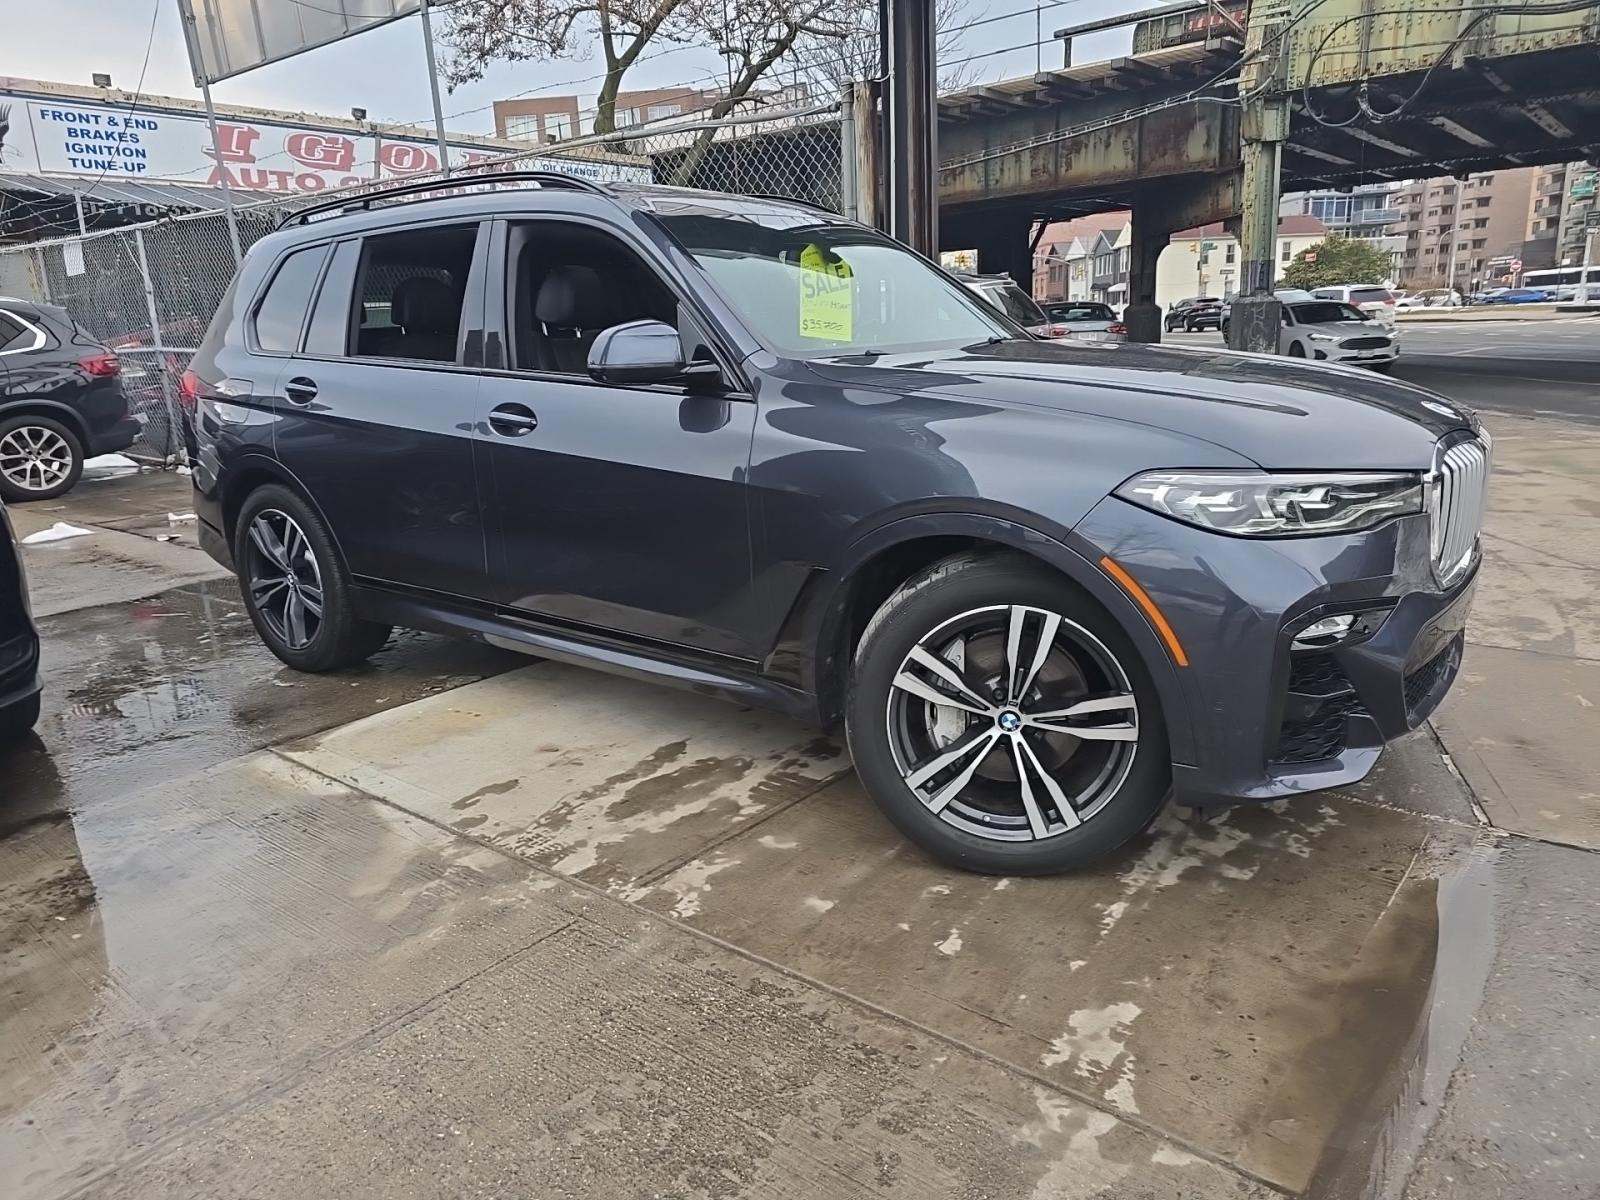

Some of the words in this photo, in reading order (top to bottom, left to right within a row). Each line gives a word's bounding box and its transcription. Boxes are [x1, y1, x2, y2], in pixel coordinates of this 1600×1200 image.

[40, 109, 101, 125] FRONT
[107, 116, 119, 127] &
[124, 118, 158, 131] END
[67, 127, 140, 144] BRAKES
[65, 142, 147, 159] IGNITION
[68, 157, 146, 173] TUNE-UP
[542, 163, 557, 172] OIL
[560, 165, 599, 177] CHANGE
[206, 166, 326, 191] AUTO
[802, 266, 849, 299] SALE
